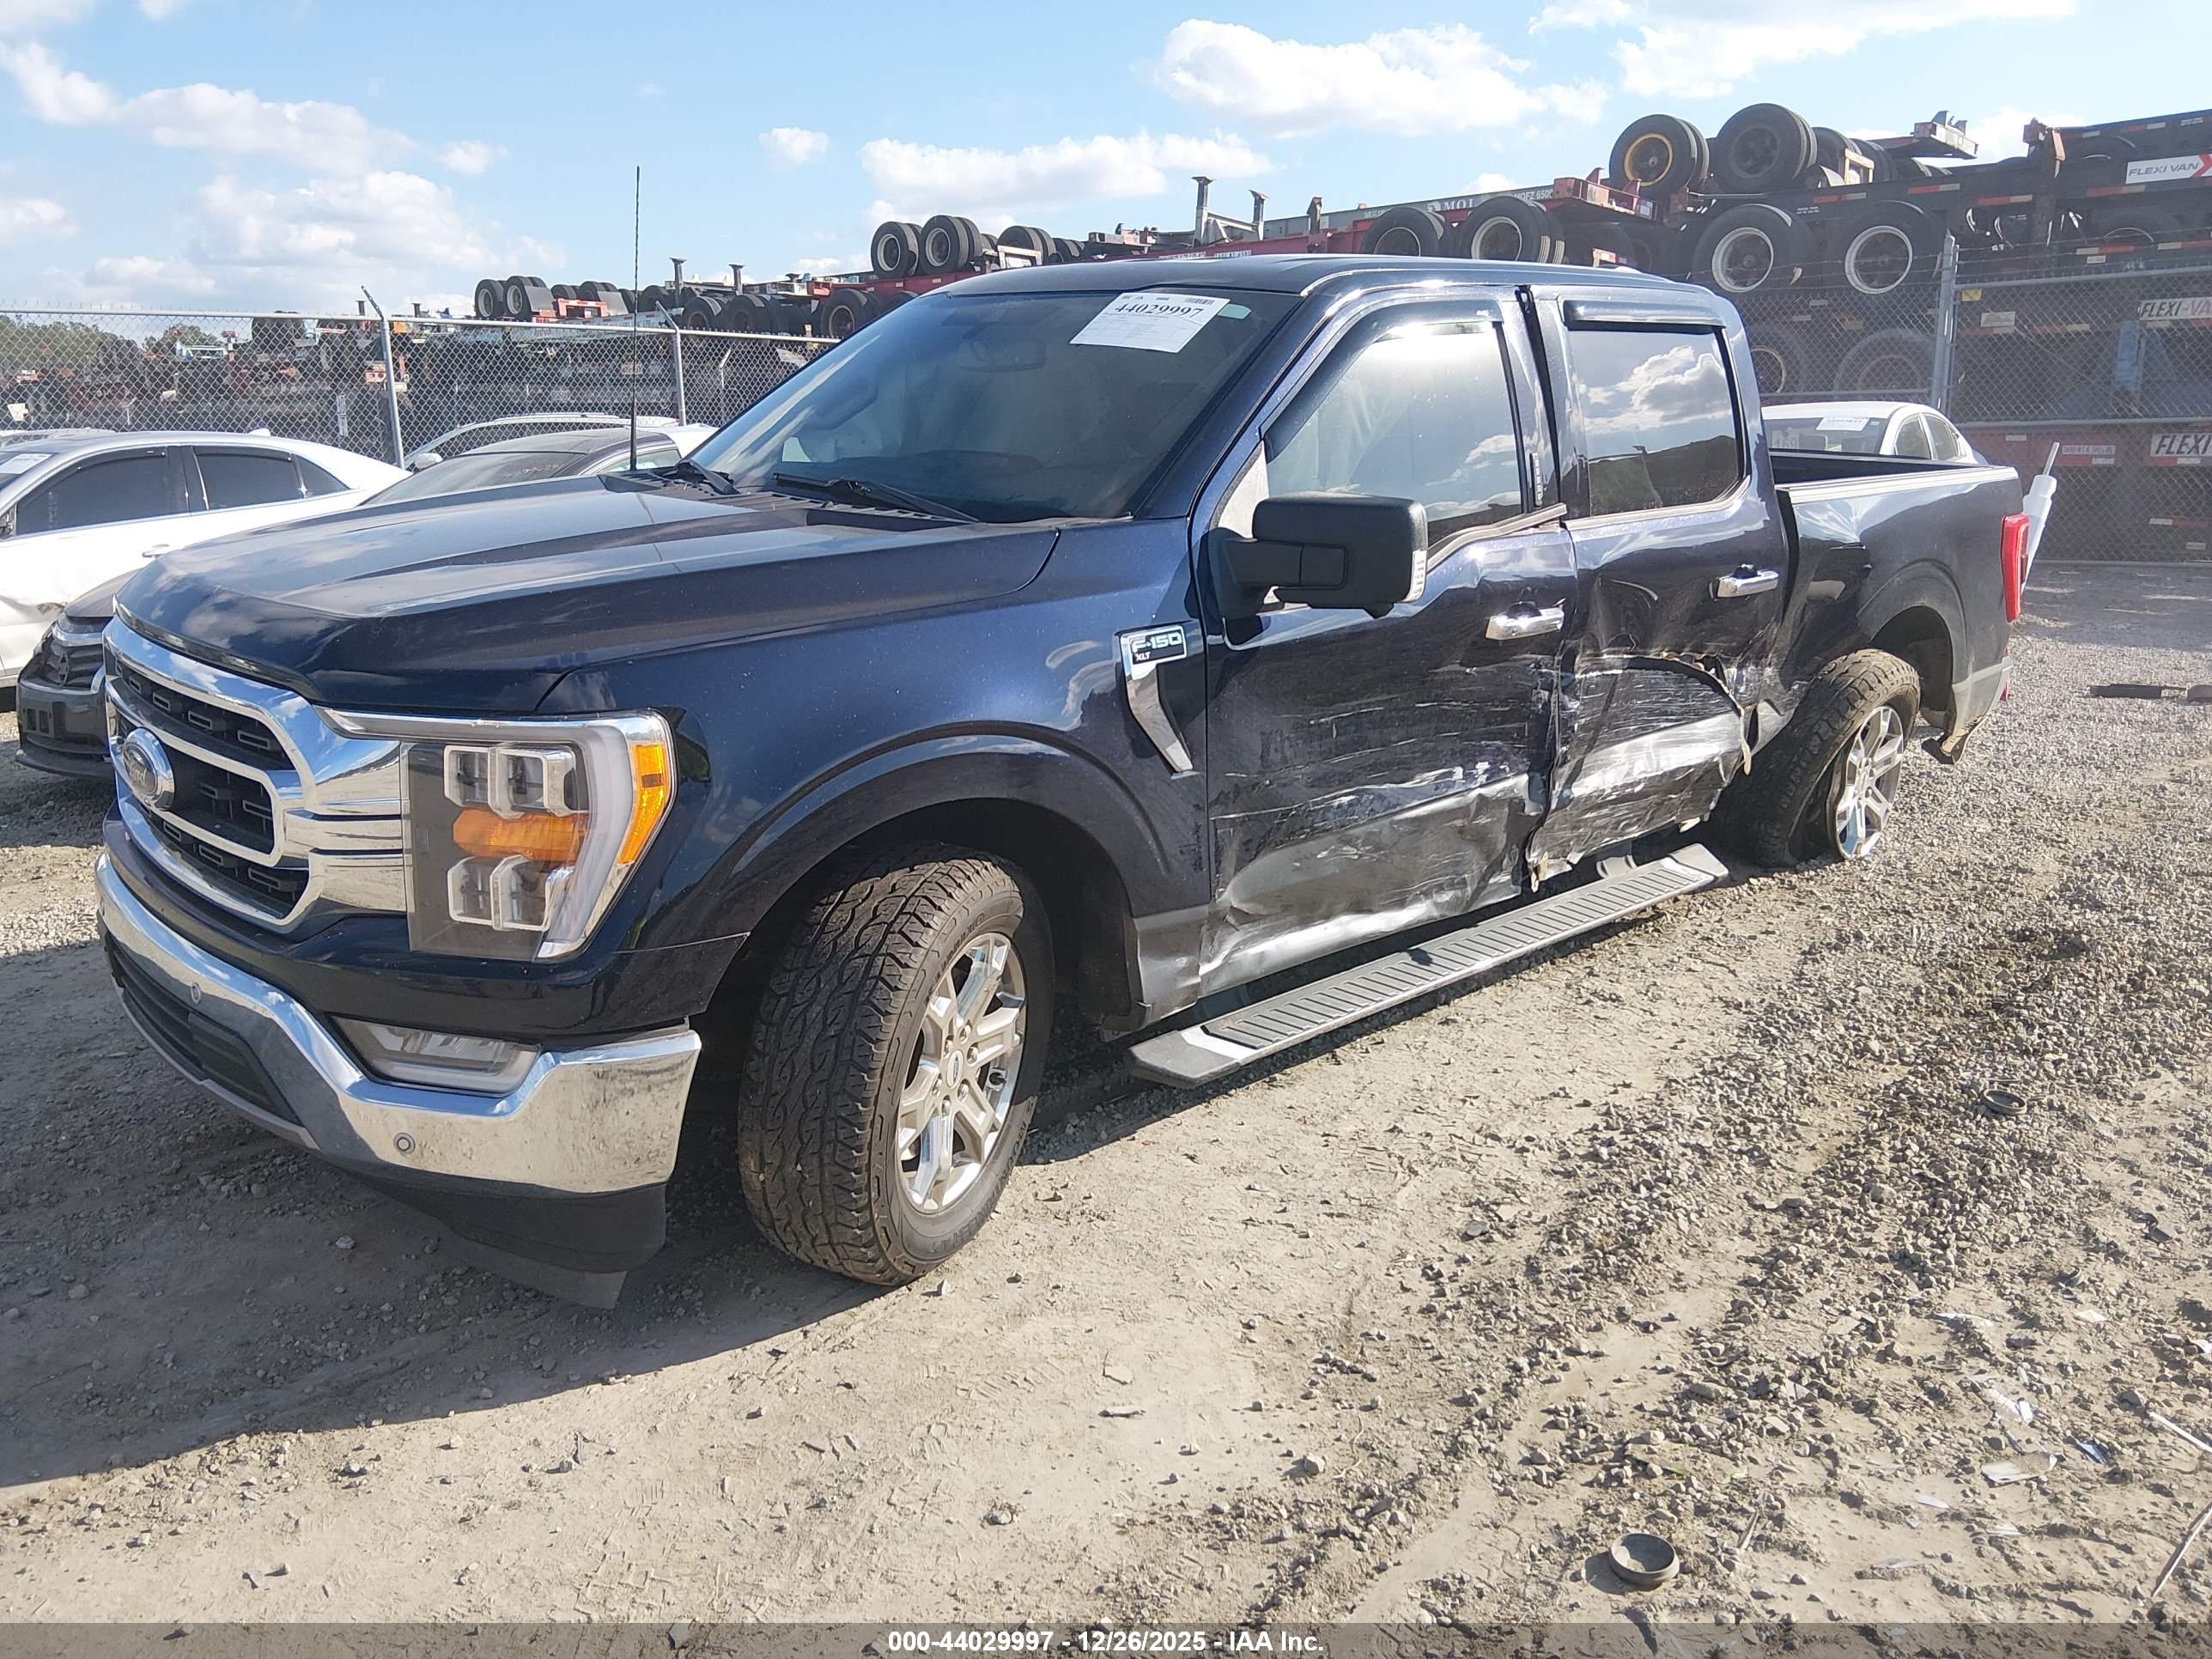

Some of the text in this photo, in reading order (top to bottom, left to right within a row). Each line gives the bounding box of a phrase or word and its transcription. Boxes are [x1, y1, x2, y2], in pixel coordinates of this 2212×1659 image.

[2129, 162, 2199, 177] FLEXI VAN
[1115, 303, 1204, 318] 44029997
[2142, 300, 2212, 317] FLEXI-VA
[1132, 632, 1182, 653] F-150
[1136, 652, 1151, 661] XLT
